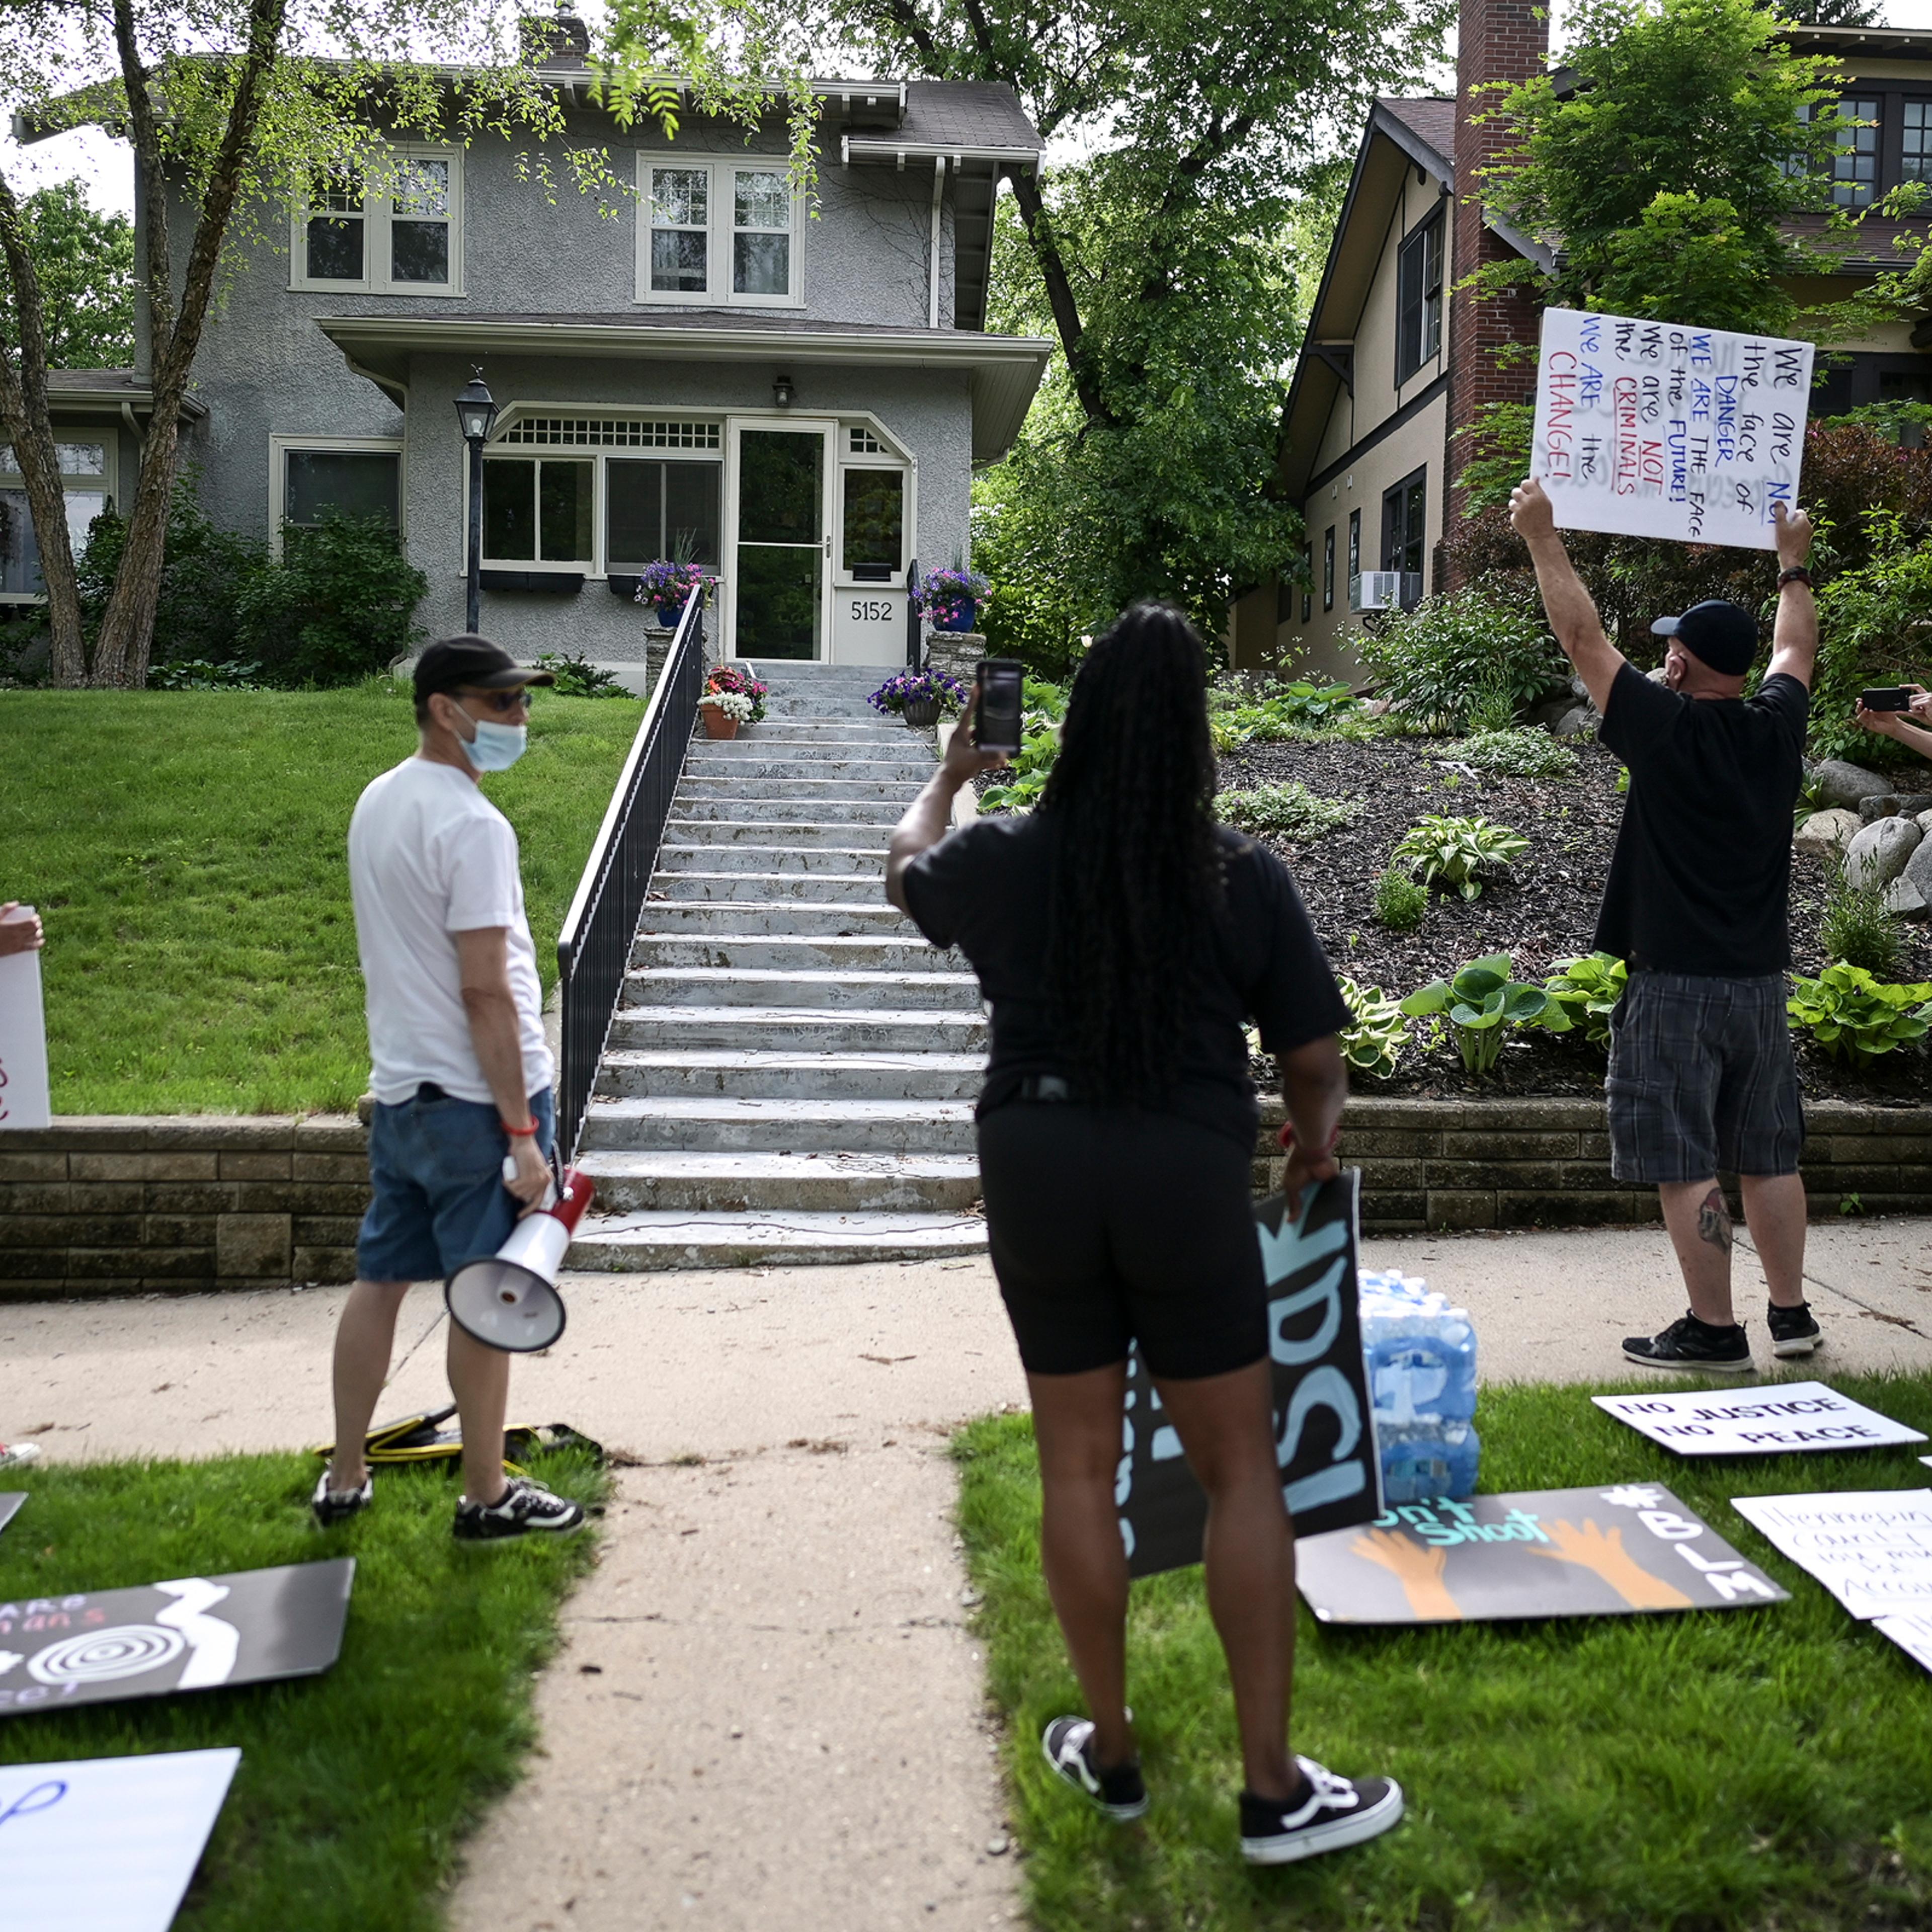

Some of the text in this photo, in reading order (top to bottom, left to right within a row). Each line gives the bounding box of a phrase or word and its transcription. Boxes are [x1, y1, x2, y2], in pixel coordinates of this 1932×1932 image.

[1691, 334, 1712, 365] WE
[1545, 351, 1577, 477] CHANGE!
[1579, 317, 1603, 479] We ARE the
[1615, 320, 1637, 495] the CRIMINALS
[1640, 325, 1664, 495] We are NOT
[1668, 332, 1688, 503] of the FUTURE!
[1692, 378, 1712, 423] ARE
[1714, 375, 1739, 467] DANGER
[1736, 342, 1767, 515] the face of
[1766, 348, 1803, 524] We are NO
[1690, 435, 1709, 474] THE
[852, 601, 892, 621] 5152
[1617, 1398, 1846, 1421] NO JUSTICE
[1653, 1424, 1881, 1443] NO PEACE
[1414, 1508, 1550, 1546] Shoot
